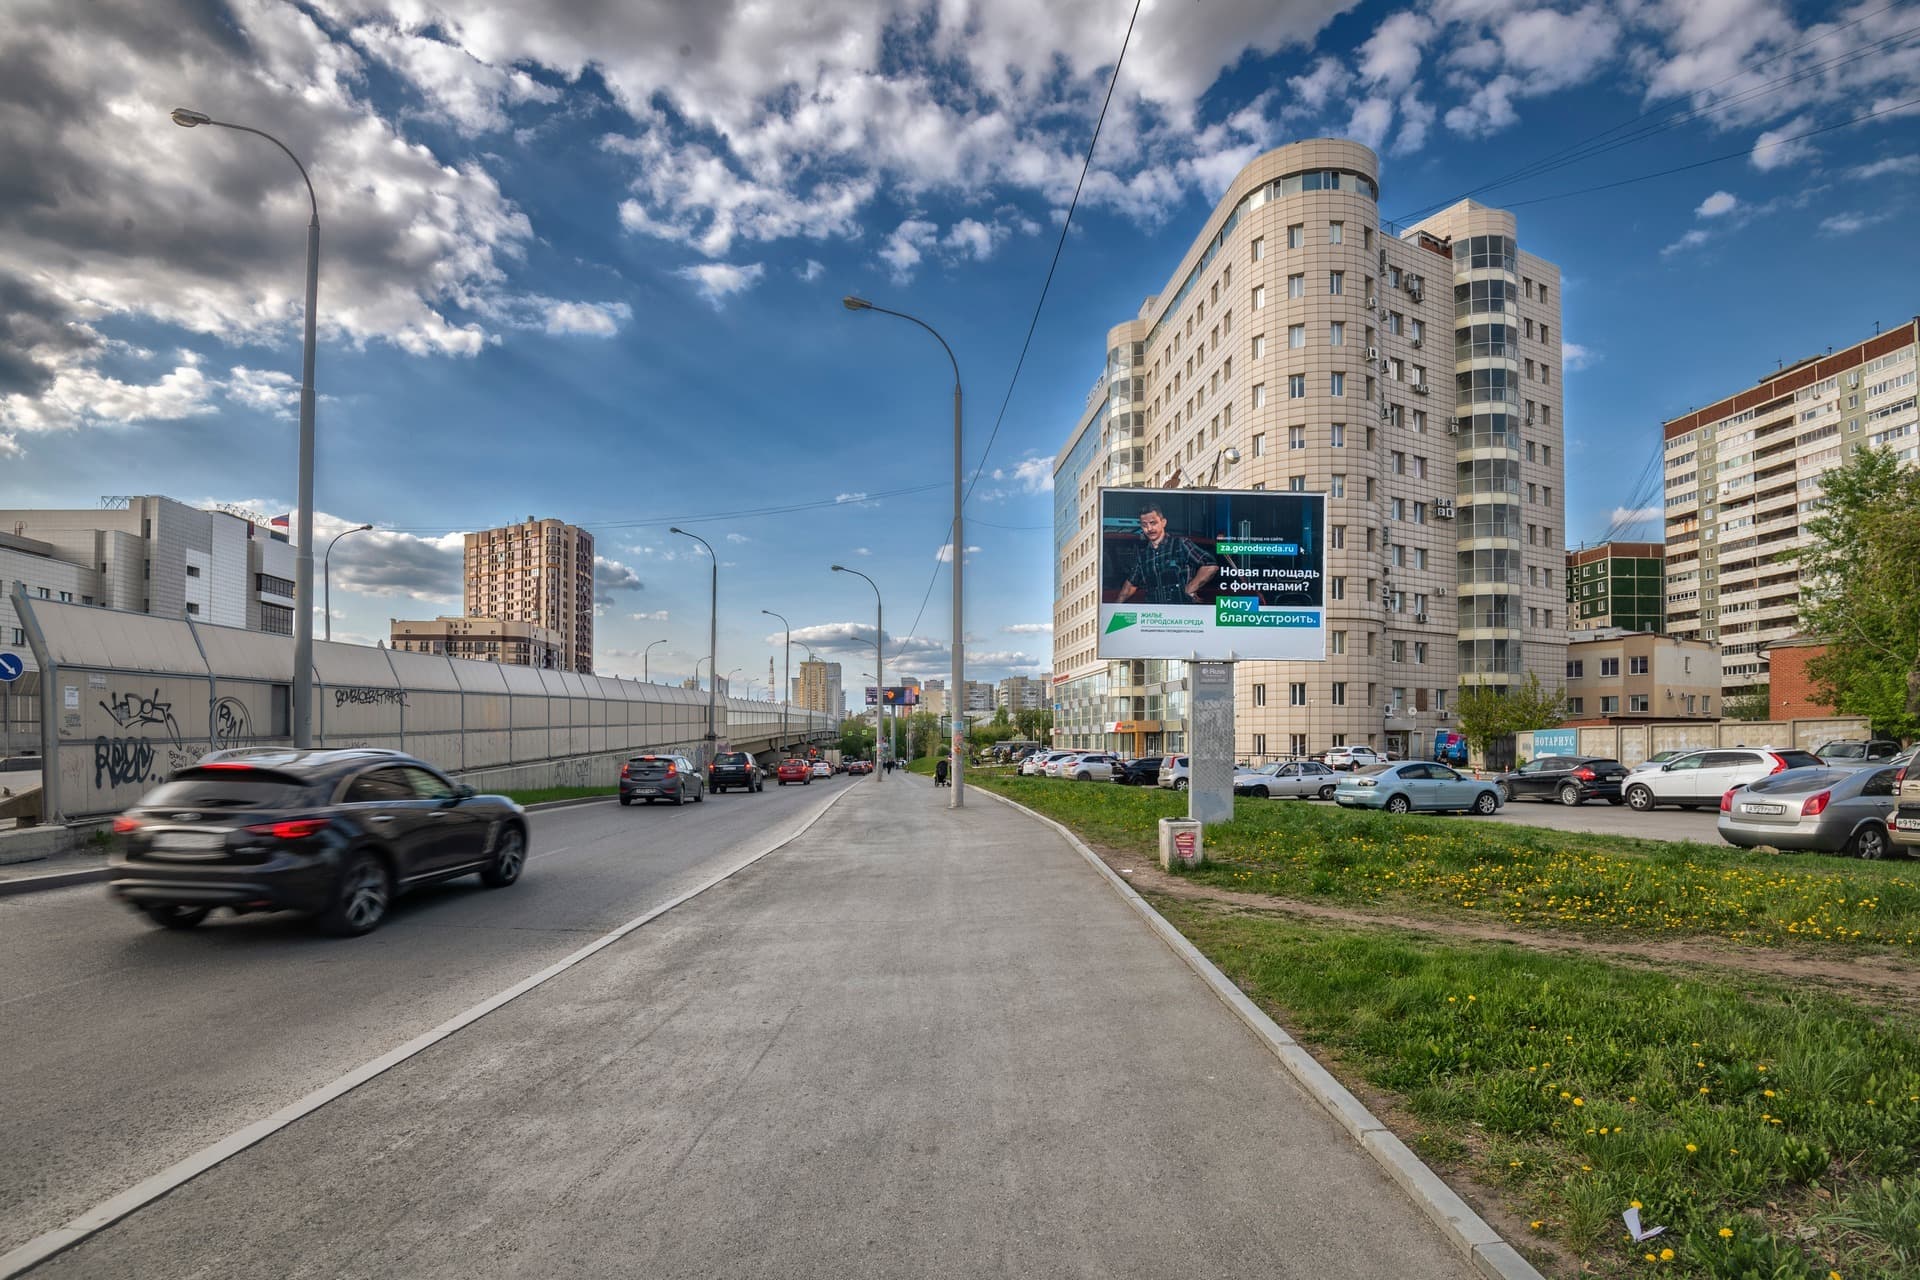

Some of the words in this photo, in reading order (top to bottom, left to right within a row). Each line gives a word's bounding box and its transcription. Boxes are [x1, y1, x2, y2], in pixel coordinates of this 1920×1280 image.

[1220, 544, 1294, 553] za.gorodsreda.ru
[1220, 566, 1259, 577] Новая
[1262, 568, 1320, 579] площадь
[1220, 583, 1228, 591] с
[1230, 580, 1310, 592] фонтанами?
[1220, 599, 1253, 611] Могу
[1220, 612, 1317, 625] благоустроить.
[1534, 735, 1575, 747] НОТАРИУС
